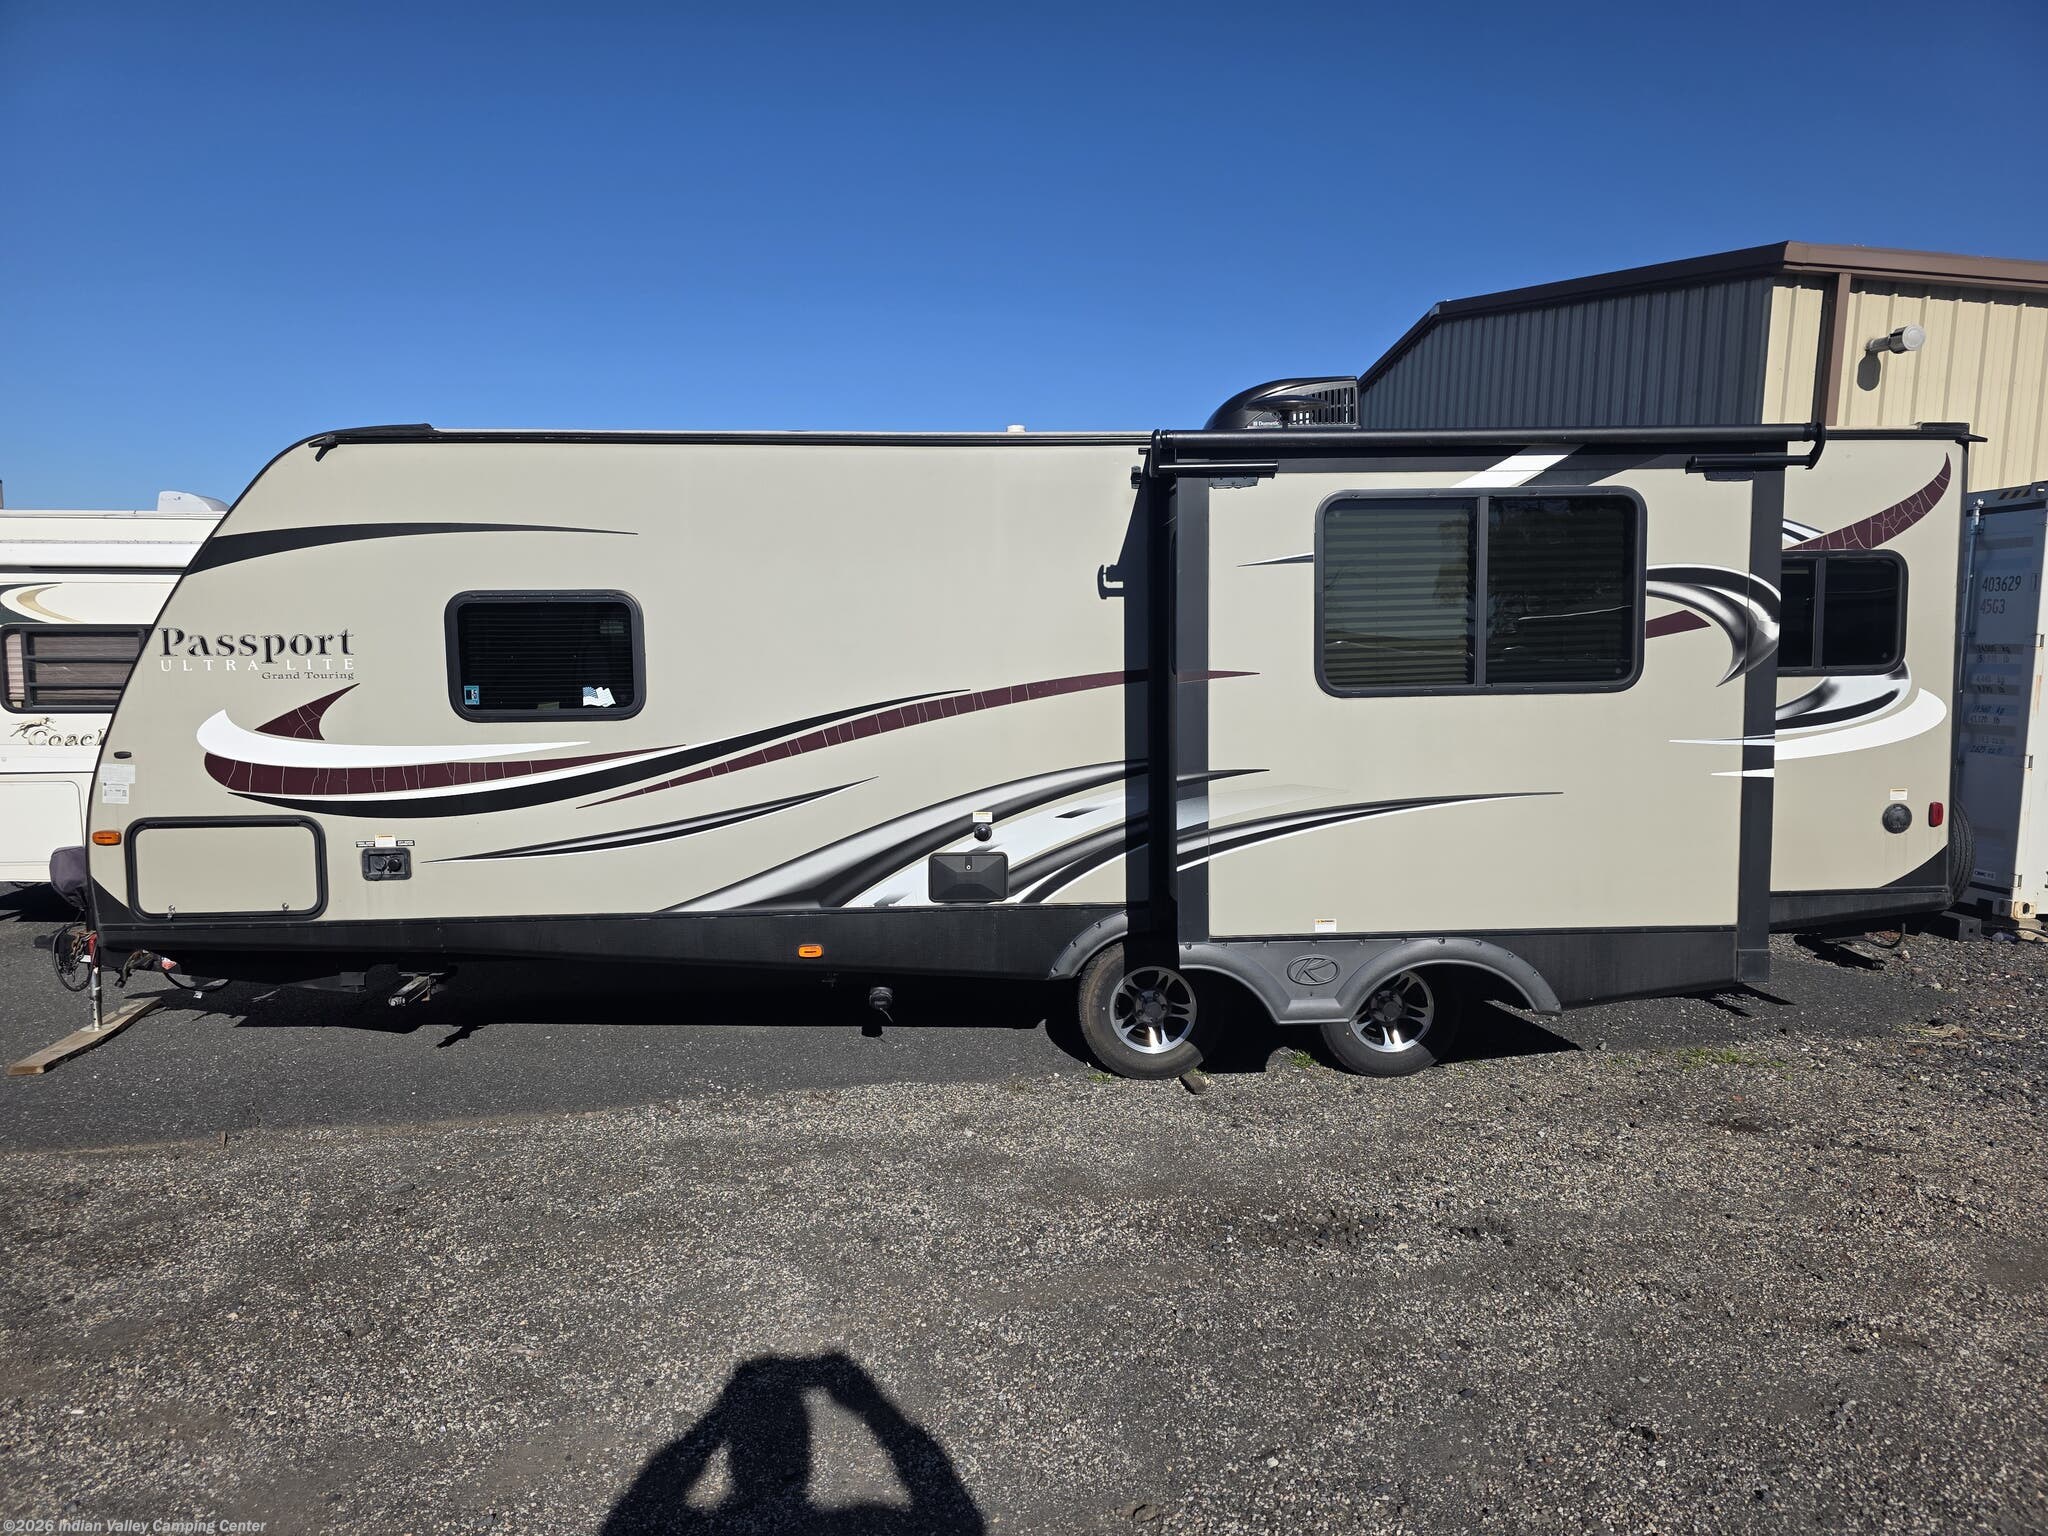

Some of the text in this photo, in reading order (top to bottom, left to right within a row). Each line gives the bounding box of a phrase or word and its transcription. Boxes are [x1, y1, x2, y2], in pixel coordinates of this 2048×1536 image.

[1982, 576, 2022, 592] 403629
[1980, 599, 2006, 614] 45G3
[158, 627, 354, 664] Passport
[160, 658, 354, 671] ULTRA LITE
[261, 671, 354, 680] Grand Touring
